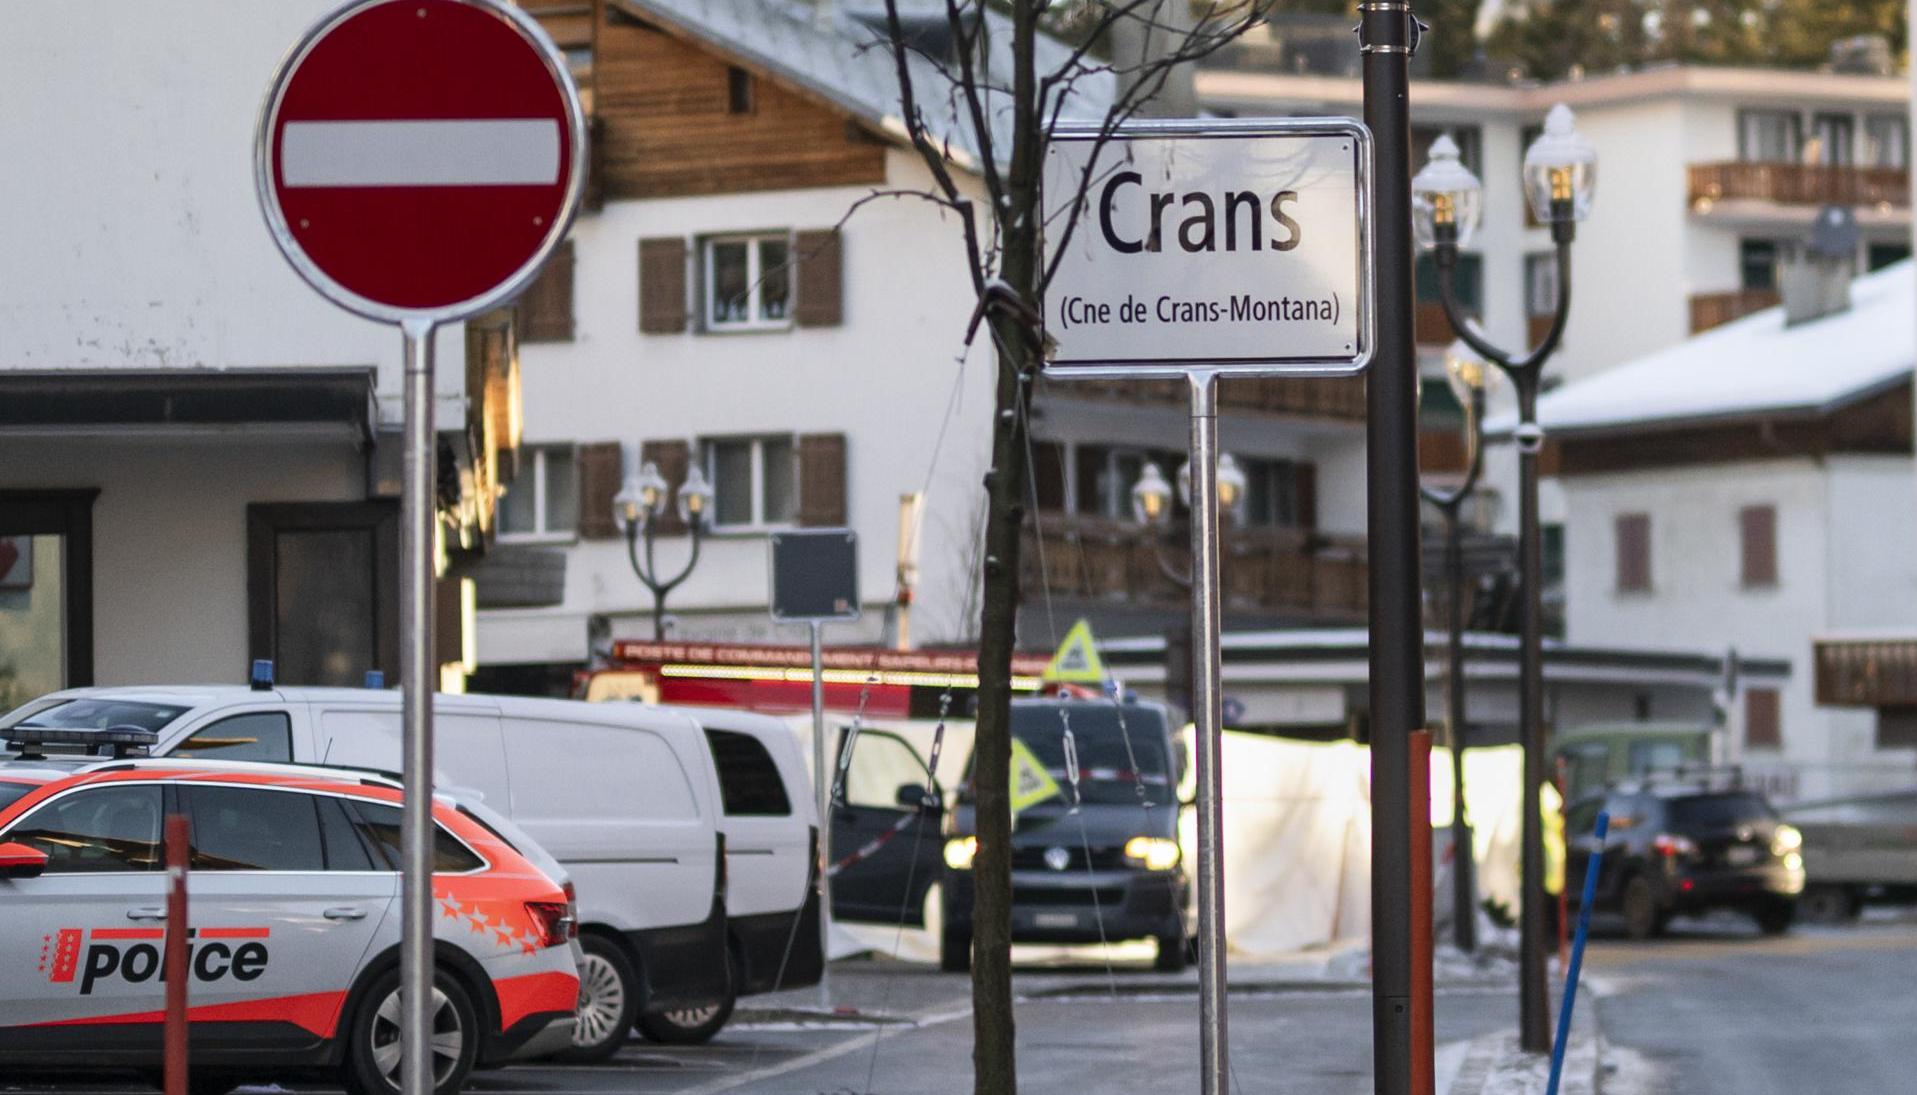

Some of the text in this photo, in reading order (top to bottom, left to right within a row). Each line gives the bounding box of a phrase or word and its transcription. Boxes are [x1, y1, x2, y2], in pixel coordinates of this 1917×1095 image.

[1099, 171, 1301, 254] Crans
[1060, 292, 1340, 329] (Cne de Crans-Montana)
